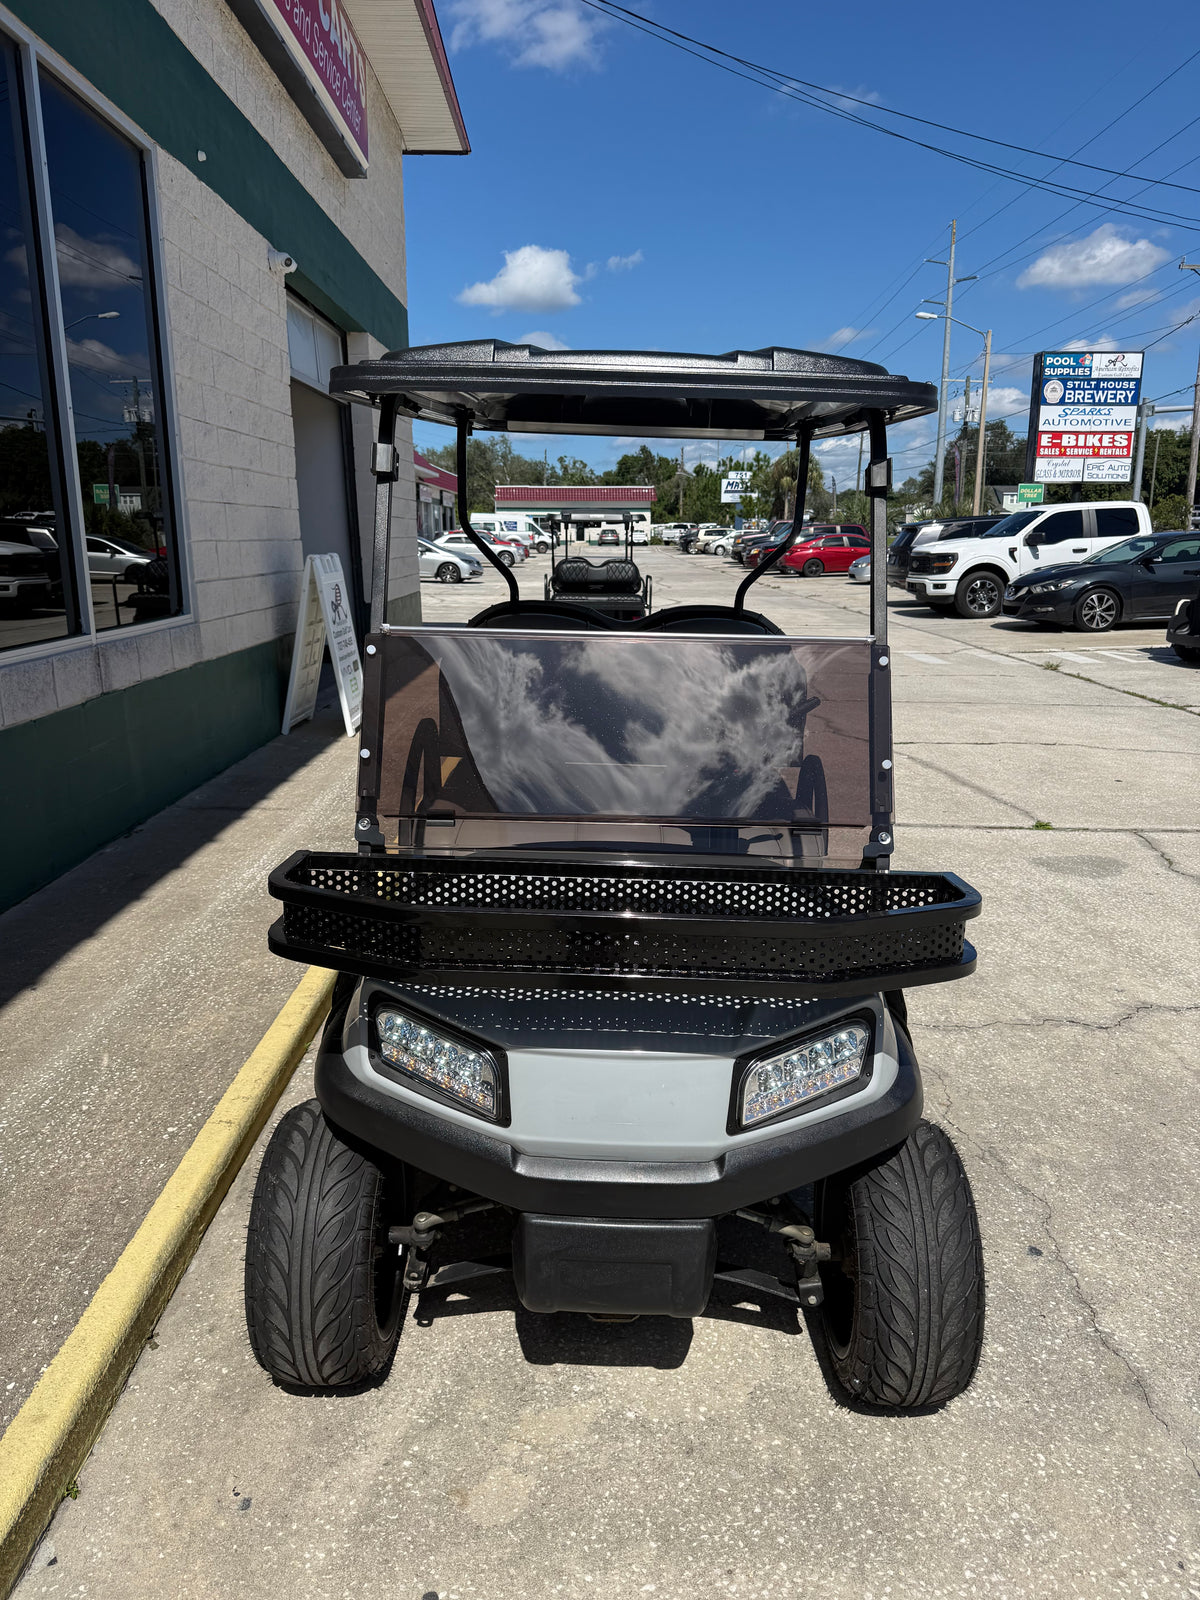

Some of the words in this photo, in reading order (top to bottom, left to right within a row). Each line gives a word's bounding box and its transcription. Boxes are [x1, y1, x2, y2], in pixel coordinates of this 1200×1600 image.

[319, 0, 366, 109] CARTS
[312, 22, 341, 97] Service
[341, 76, 361, 136] Center
[1046, 356, 1076, 366] POOL
[1044, 367, 1091, 376] SUPPLIES
[1066, 381, 1097, 389] STILT
[1065, 390, 1135, 403] BREWERY
[1058, 407, 1113, 418] SPARKS
[1042, 418, 1132, 427] AUTOMOTIVE
[1040, 434, 1128, 447] E-BIKES
[1066, 448, 1093, 456] SERVICE
[1099, 448, 1128, 456] RENTALS
